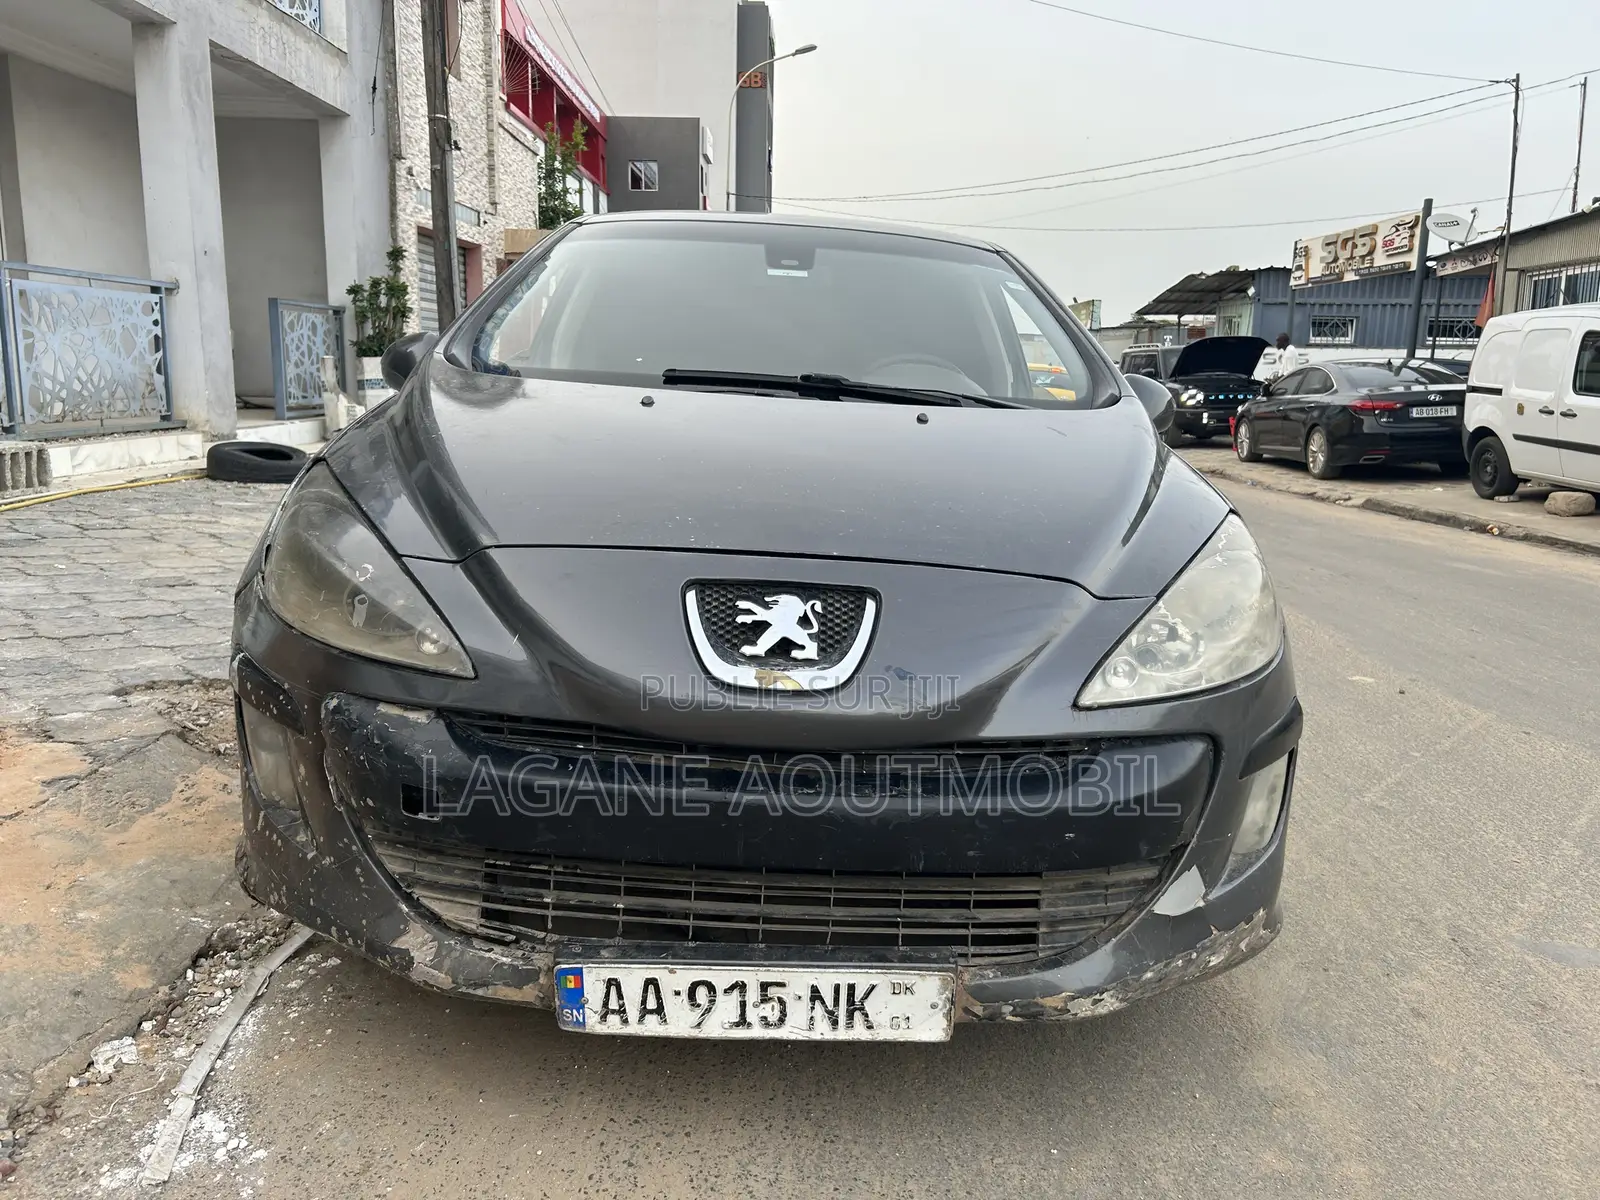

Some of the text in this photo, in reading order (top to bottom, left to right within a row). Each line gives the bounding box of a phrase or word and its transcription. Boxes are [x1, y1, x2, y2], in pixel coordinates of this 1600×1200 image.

[1320, 224, 1376, 263] SGS
[1382, 238, 1395, 249] SGS
[1321, 256, 1374, 276] AUTOMOBILE
[1415, 408, 1424, 416] AB
[1425, 408, 1438, 416] 018
[1439, 407, 1449, 415] FH
[891, 979, 916, 995] DK
[562, 1008, 584, 1022] SN
